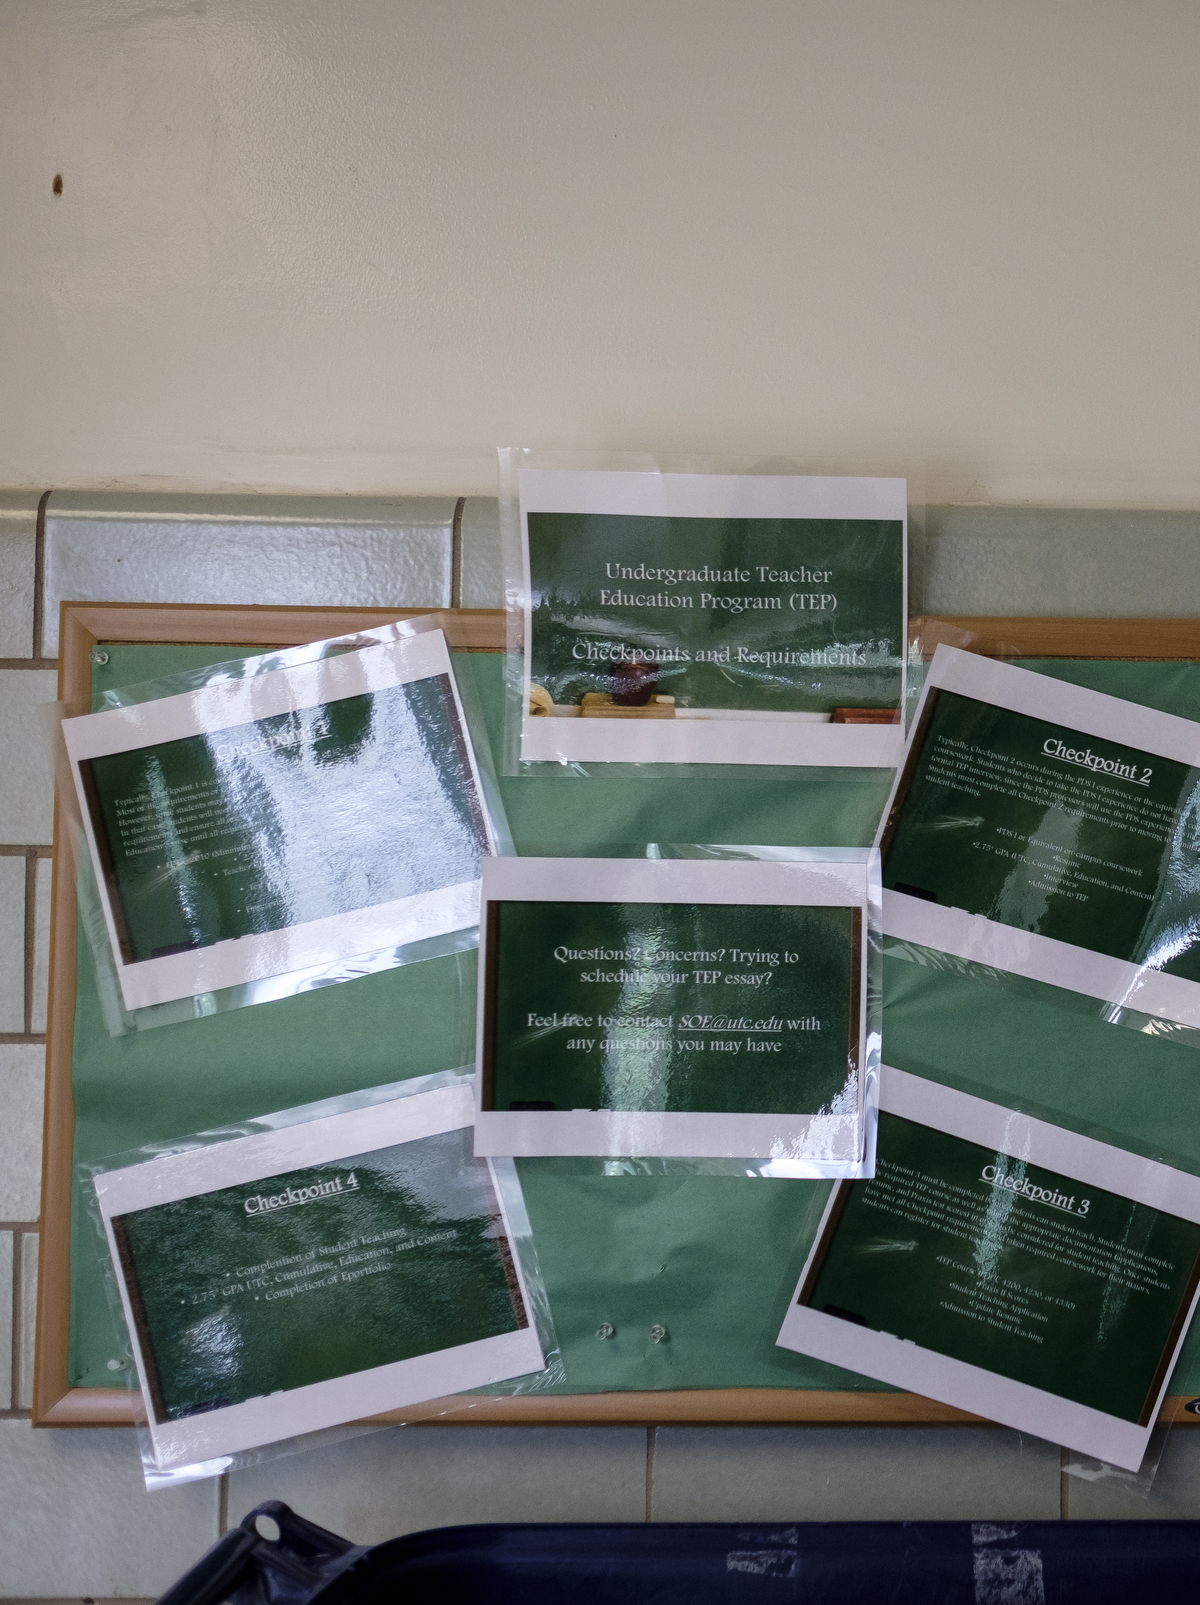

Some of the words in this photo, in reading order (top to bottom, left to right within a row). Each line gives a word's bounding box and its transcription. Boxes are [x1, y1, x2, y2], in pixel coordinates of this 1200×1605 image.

[605, 563, 750, 584] Undergraduate
[755, 566, 833, 583] Teacher
[599, 589, 693, 608] Education
[700, 593, 782, 613] Program
[789, 593, 837, 611] (TEP)
[572, 641, 691, 664] Checkpoints
[695, 646, 730, 667] and
[734, 647, 866, 667] Requirements
[1041, 739, 1136, 781] Checkpoint
[1139, 767, 1153, 783] 2
[553, 946, 641, 965] Questions?
[644, 945, 726, 964] Concerns?
[729, 948, 780, 967] Trying
[784, 950, 799, 963] to
[580, 968, 648, 983] schedule
[652, 972, 689, 987] your
[692, 970, 721, 984] TEP
[724, 971, 772, 988] essay?
[527, 1012, 558, 1028] Feel
[562, 1013, 593, 1028] free
[597, 1014, 614, 1029] to
[616, 1013, 674, 1029] contact
[677, 1014, 784, 1032] SOE@utc.edu
[786, 1016, 821, 1031] with
[566, 1038, 596, 1053] any
[599, 1035, 674, 1055] questions
[676, 1040, 705, 1054] you
[709, 1040, 742, 1055] may
[746, 1037, 782, 1052] have
[243, 1177, 343, 1215] Checkpoint
[346, 1172, 359, 1188] 4
[981, 1165, 1073, 1211] Checkpoint
[1076, 1198, 1090, 1215] 3
[265, 1279, 324, 1301] Completion
[327, 1275, 338, 1286] of
[341, 1262, 392, 1282] Eportfolio
